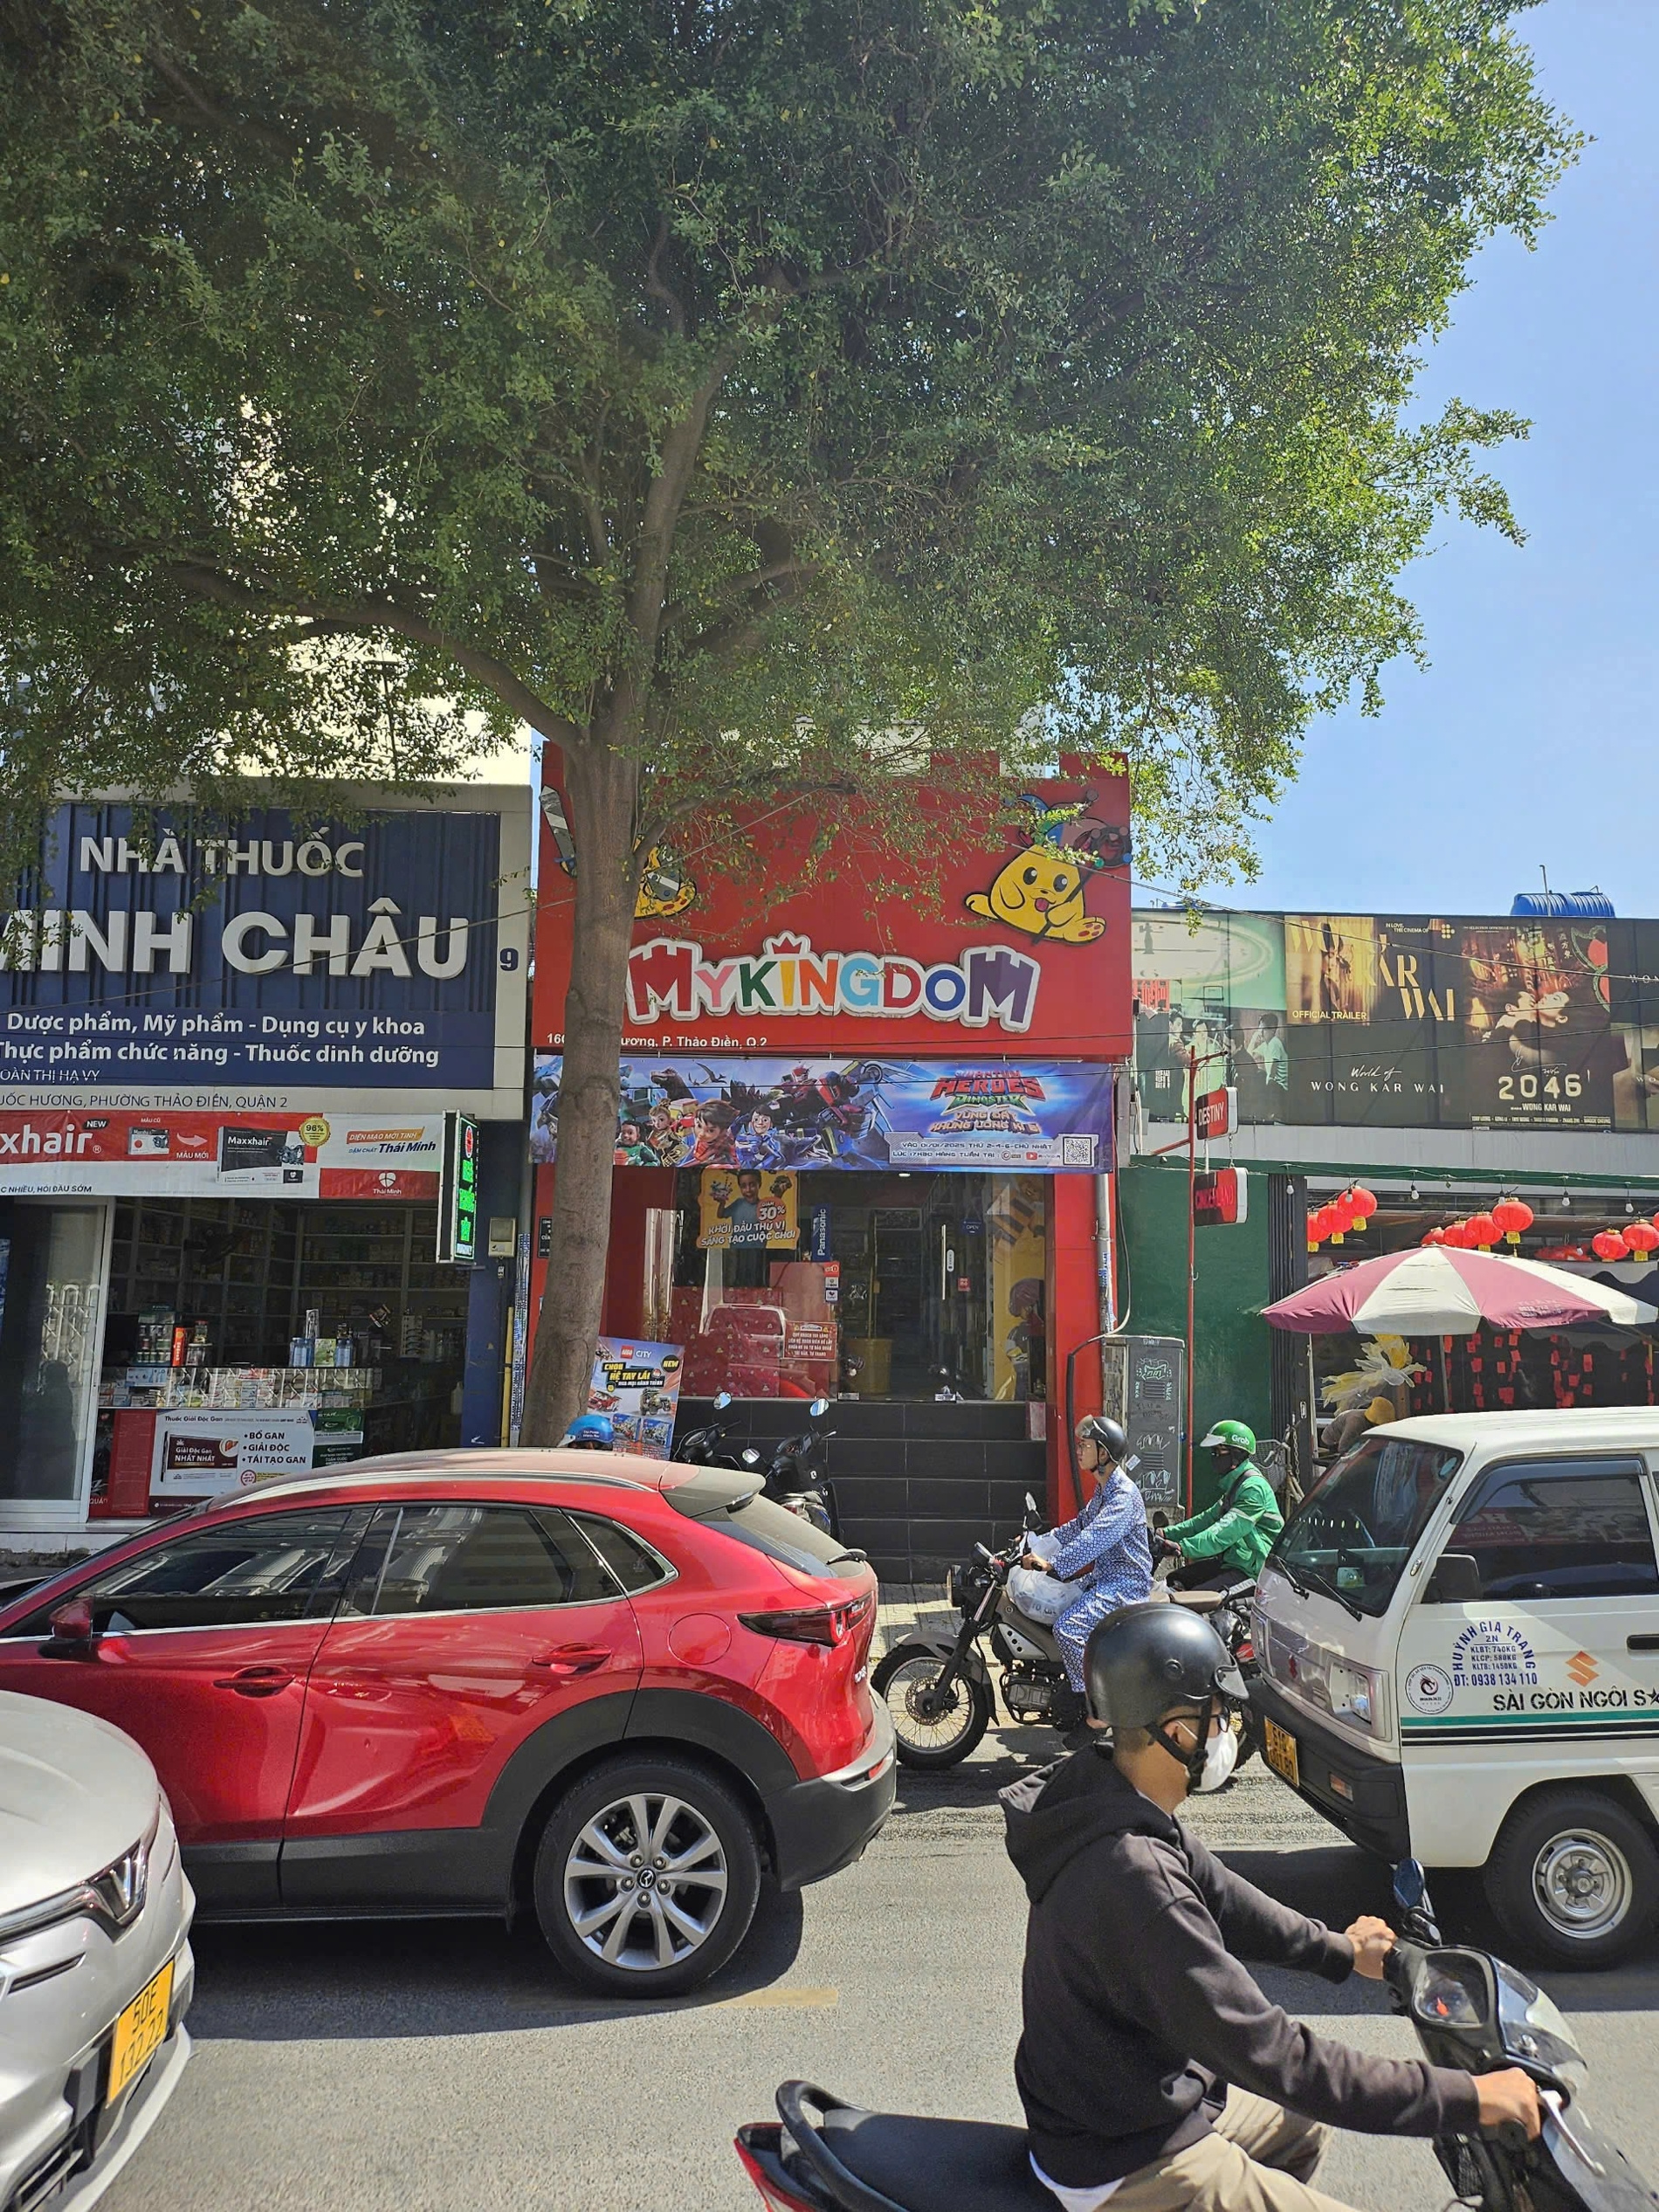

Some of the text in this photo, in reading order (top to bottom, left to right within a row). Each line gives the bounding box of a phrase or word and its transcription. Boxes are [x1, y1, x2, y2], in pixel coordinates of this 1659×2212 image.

[80, 827, 365, 877] NHÀ THUỐC
[222, 897, 469, 979] CHÂU
[499, 948, 519, 971] 9
[629, 933, 1039, 1030] MYKINGDOM
[1292, 1010, 1367, 1020] OFFICIAL TRAILER
[7, 1012, 64, 1035] Dược
[69, 1010, 138, 1035] phẩm,
[143, 1014, 176, 1037] Mỹ
[182, 1011, 243, 1037] phẩm
[262, 1016, 320, 1038] Dụng
[326, 1021, 349, 1039] cụ
[355, 1021, 368, 1038] y
[373, 1016, 425, 1035] khoa
[621, 1037, 658, 1048] ương,
[662, 1036, 672, 1046] P.
[677, 1036, 708, 1047] Thảo
[49, 1039, 112, 1064] phẩm
[117, 1042, 168, 1060] chức
[174, 1043, 228, 1065] năng
[245, 1042, 311, 1062] Thuốc
[316, 1045, 364, 1063] dinh
[369, 1045, 439, 1068] dưỡng
[33, 1070, 56, 1084] THỊ
[59, 1070, 79, 1084] HẠ
[82, 1070, 101, 1081] VY
[1351, 1065, 1402, 1081] World of
[930, 1078, 1046, 1101] HEROES
[1311, 1082, 1443, 1092] WONG KAR WAI
[1498, 1074, 1582, 1099] 2046
[29, 1094, 86, 1108] HƯƠNG,
[90, 1092, 150, 1107] PHƯỜNG
[153, 1092, 193, 1107] THẢO
[236, 1094, 276, 1110] QUẬN
[280, 1098, 287, 1107] 2
[1198, 1102, 1224, 1126] DESTINY
[0, 1124, 93, 1155] xhair
[228, 1136, 269, 1146] Maxxhair
[379, 1142, 406, 1154] Thái
[406, 1140, 436, 1152] Minh
[71, 1184, 92, 1193] SỚM
[759, 1206, 786, 1221] 30%
[733, 1221, 752, 1233] ĐẦU
[818, 1209, 827, 1256] Panasonic
[701, 1237, 725, 1246] SÁNG
[727, 1235, 746, 1244] TẠO
[747, 1233, 772, 1243] CUỘC
[269, 1443, 290, 1453] ĐỘC
[1231, 1434, 1250, 1445] Grab
[248, 1453, 263, 1464] TÁI
[265, 1456, 285, 1465] TẠO
[1479, 1621, 1502, 1633] GIA
[1506, 1626, 1536, 1669] TRANG
[1455, 1672, 1538, 1686] ĐT: 0938 134 110
[1493, 1689, 1525, 1711] SÀI
[1530, 1688, 1574, 1710] GÒN
[1580, 1685, 1628, 1708] NGÔI
[132, 1979, 159, 2035] 50E
